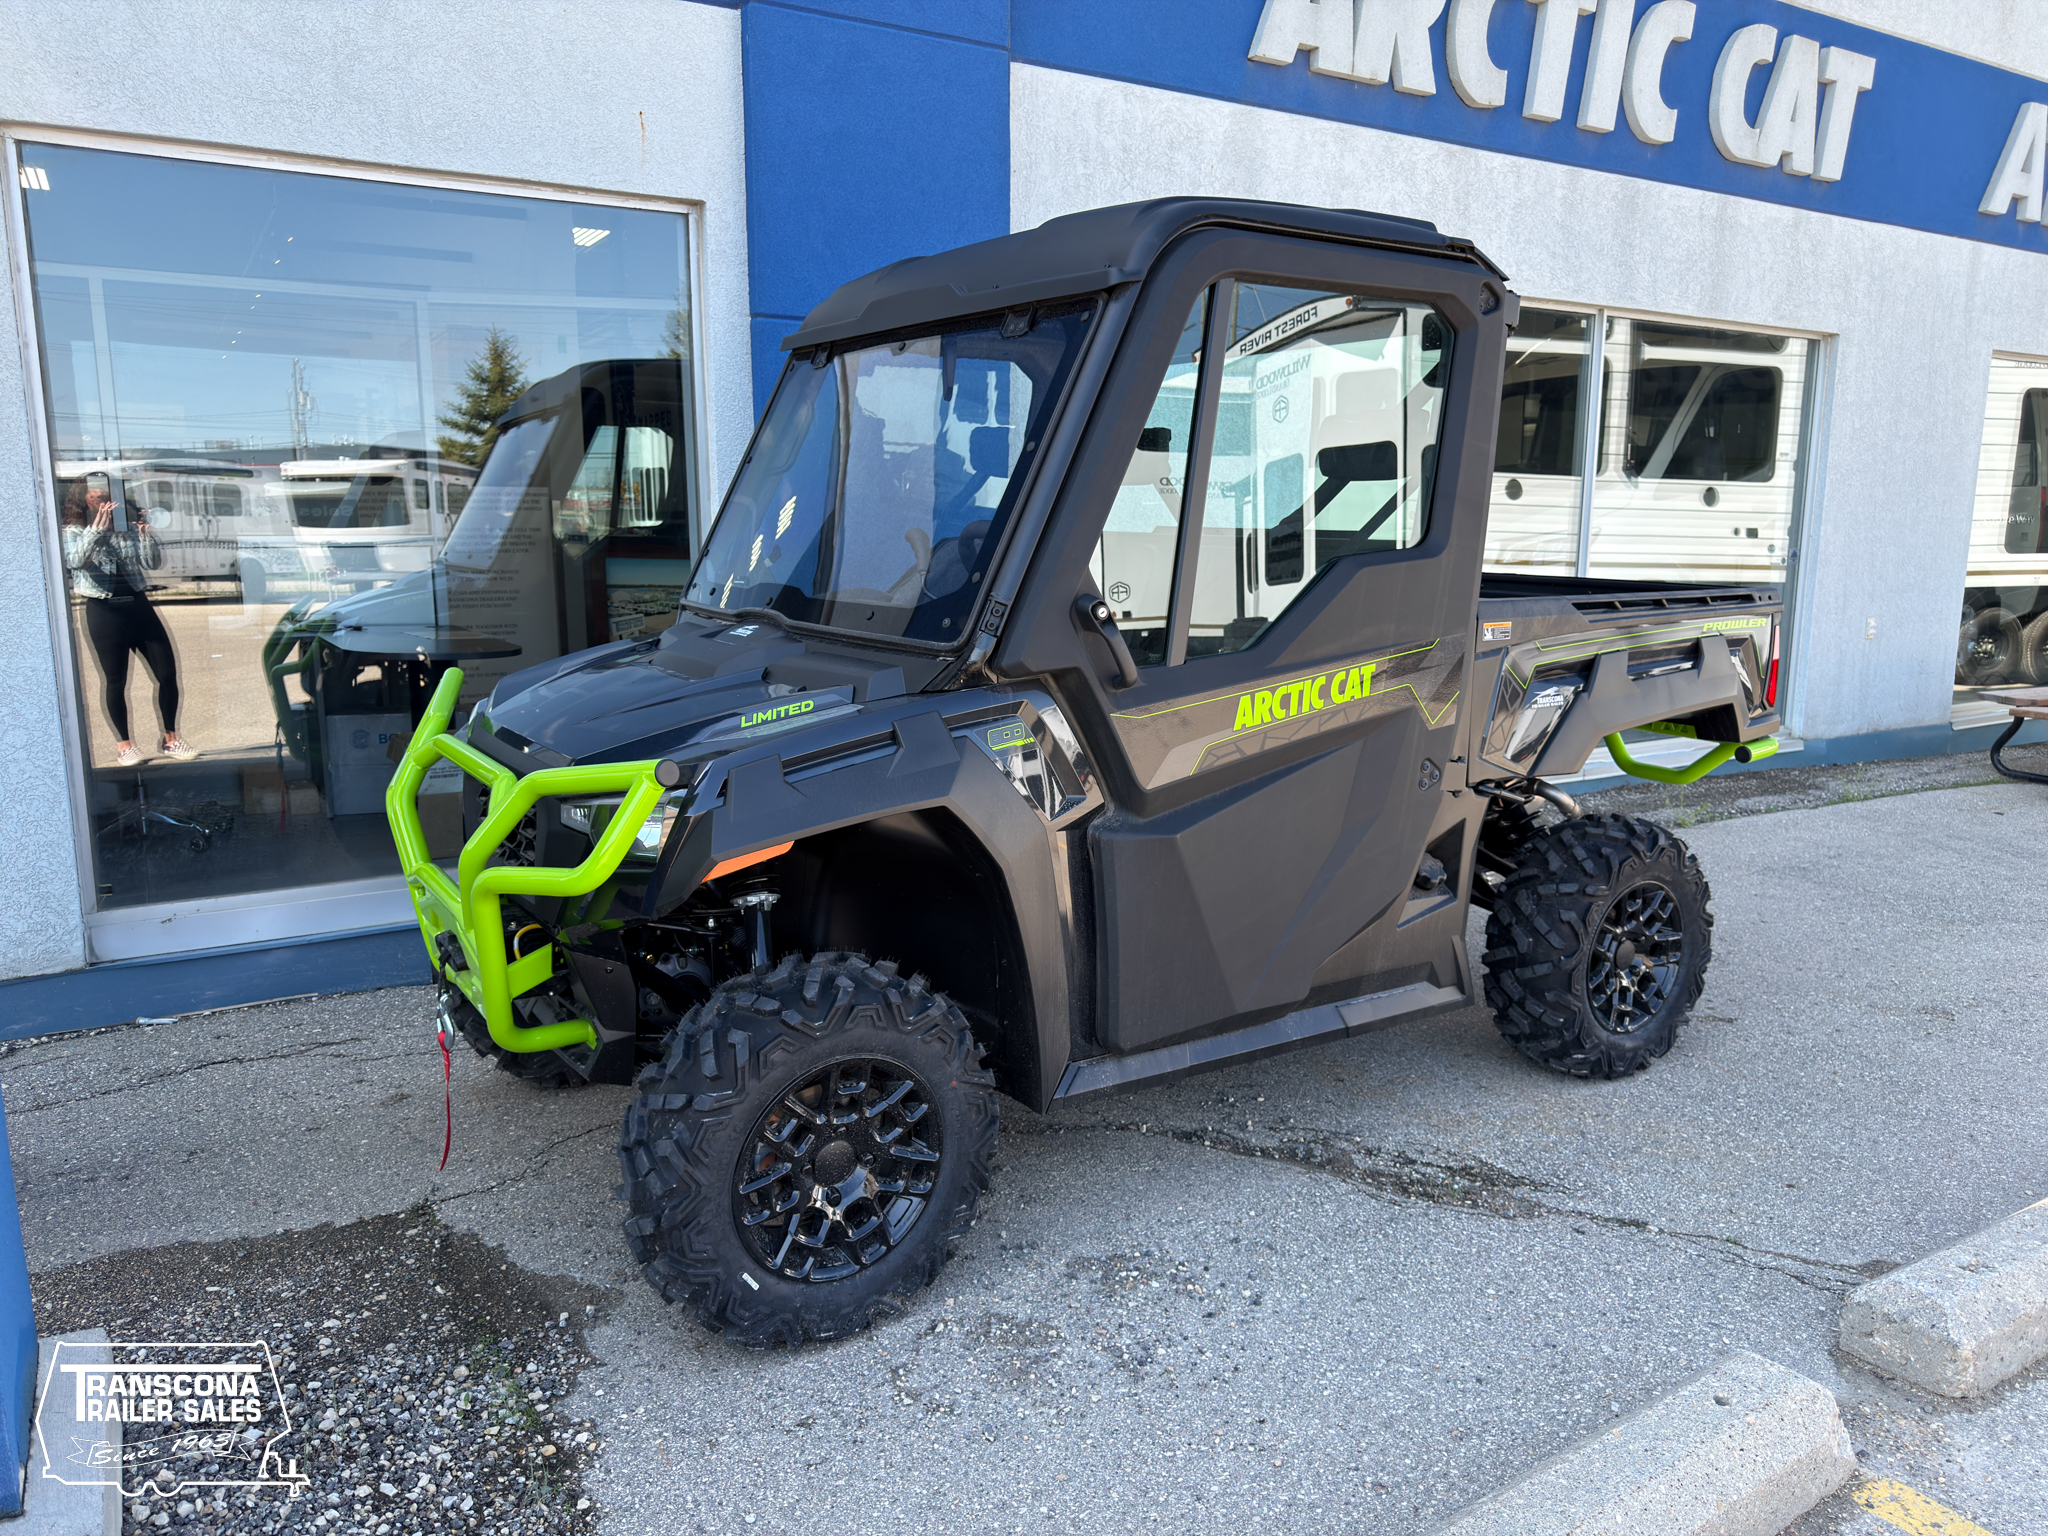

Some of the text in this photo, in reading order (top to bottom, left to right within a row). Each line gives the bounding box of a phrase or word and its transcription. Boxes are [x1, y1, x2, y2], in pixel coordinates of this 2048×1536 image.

[1247, 0, 1876, 183] ARCTIC CAT
[1702, 618, 1767, 632] PROWLER
[740, 699, 815, 728] LIMITED
[1233, 663, 1376, 731] ARCTIC CAT
